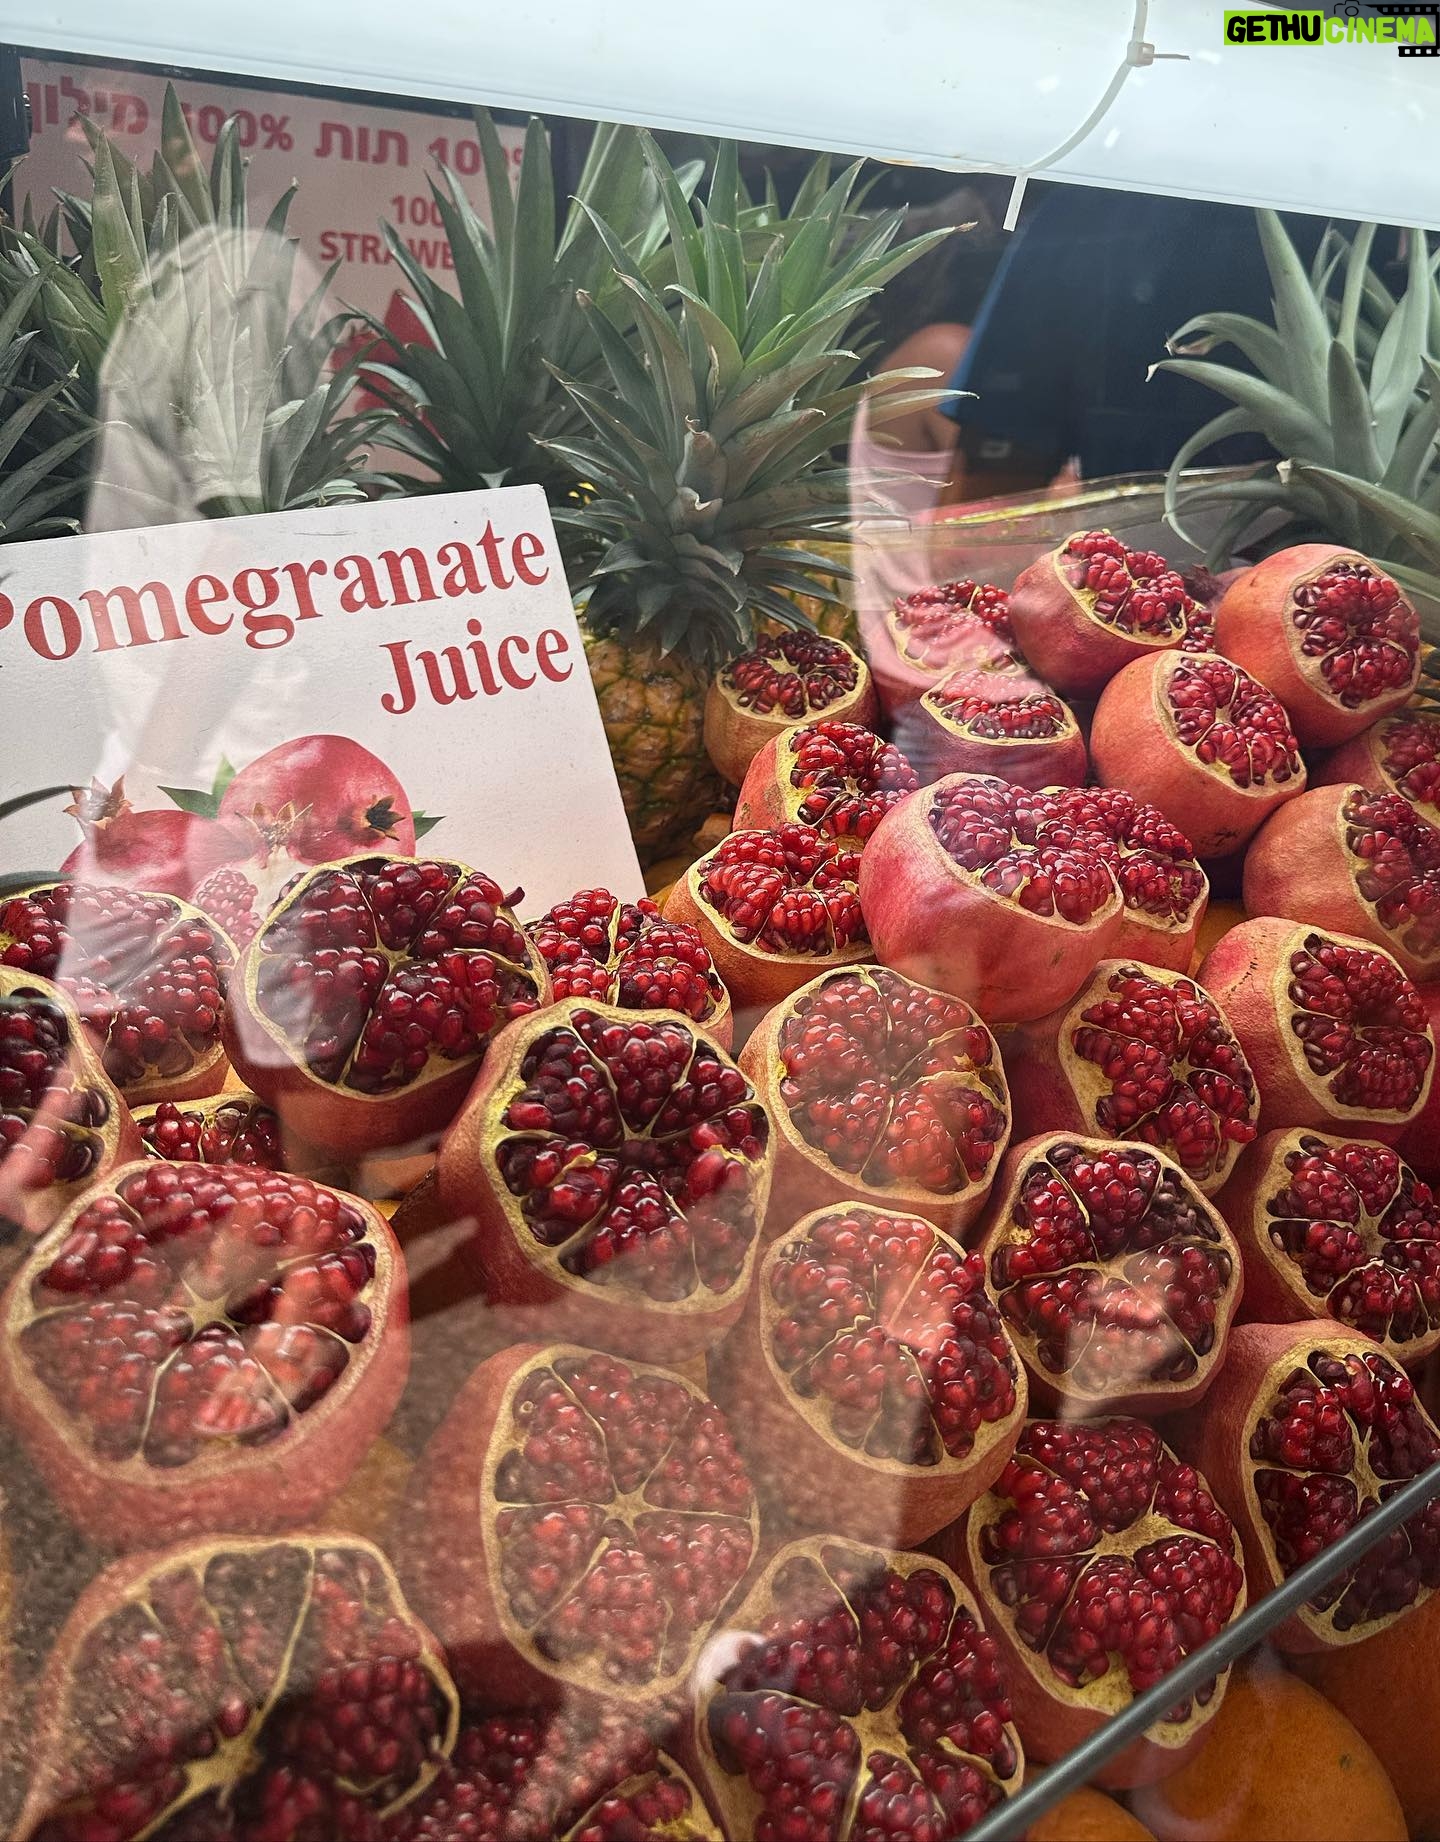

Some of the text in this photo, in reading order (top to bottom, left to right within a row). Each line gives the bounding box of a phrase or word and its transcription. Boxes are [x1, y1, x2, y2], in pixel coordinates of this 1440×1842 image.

[27, 76, 148, 134] מילון
[314, 121, 523, 182] 10 תות
[0, 519, 550, 661] omegranate
[380, 618, 574, 715] Juice
